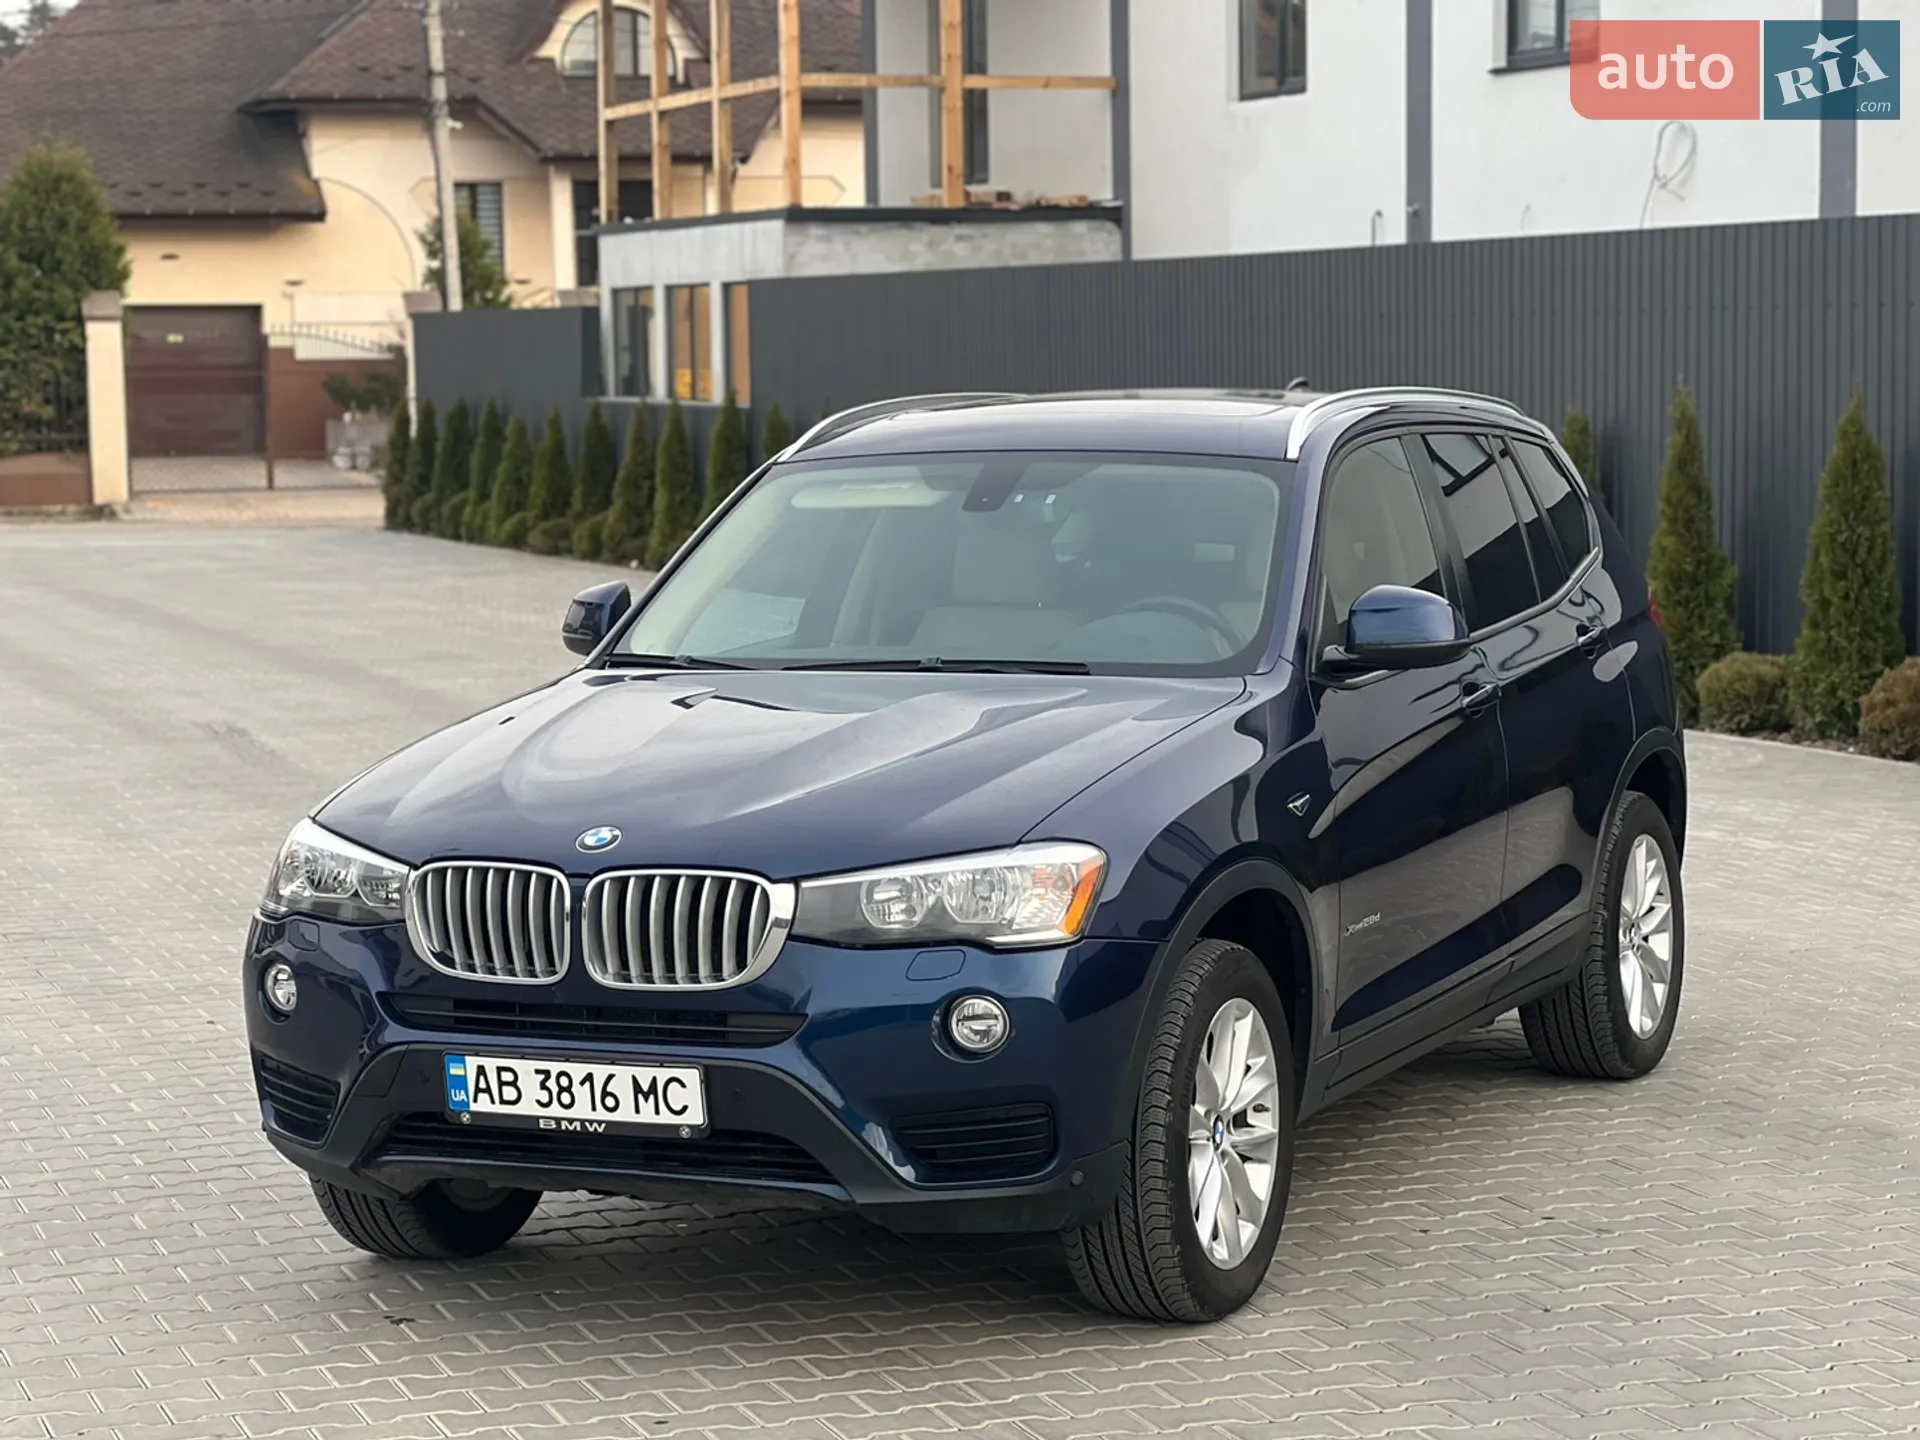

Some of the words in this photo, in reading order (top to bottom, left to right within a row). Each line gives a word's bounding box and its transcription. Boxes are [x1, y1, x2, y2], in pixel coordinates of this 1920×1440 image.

[451, 1088, 467, 1102] UA
[472, 1064, 522, 1106] AB
[533, 1068, 620, 1113] 3816
[631, 1074, 689, 1116] MC
[538, 1118, 607, 1133] BMW
